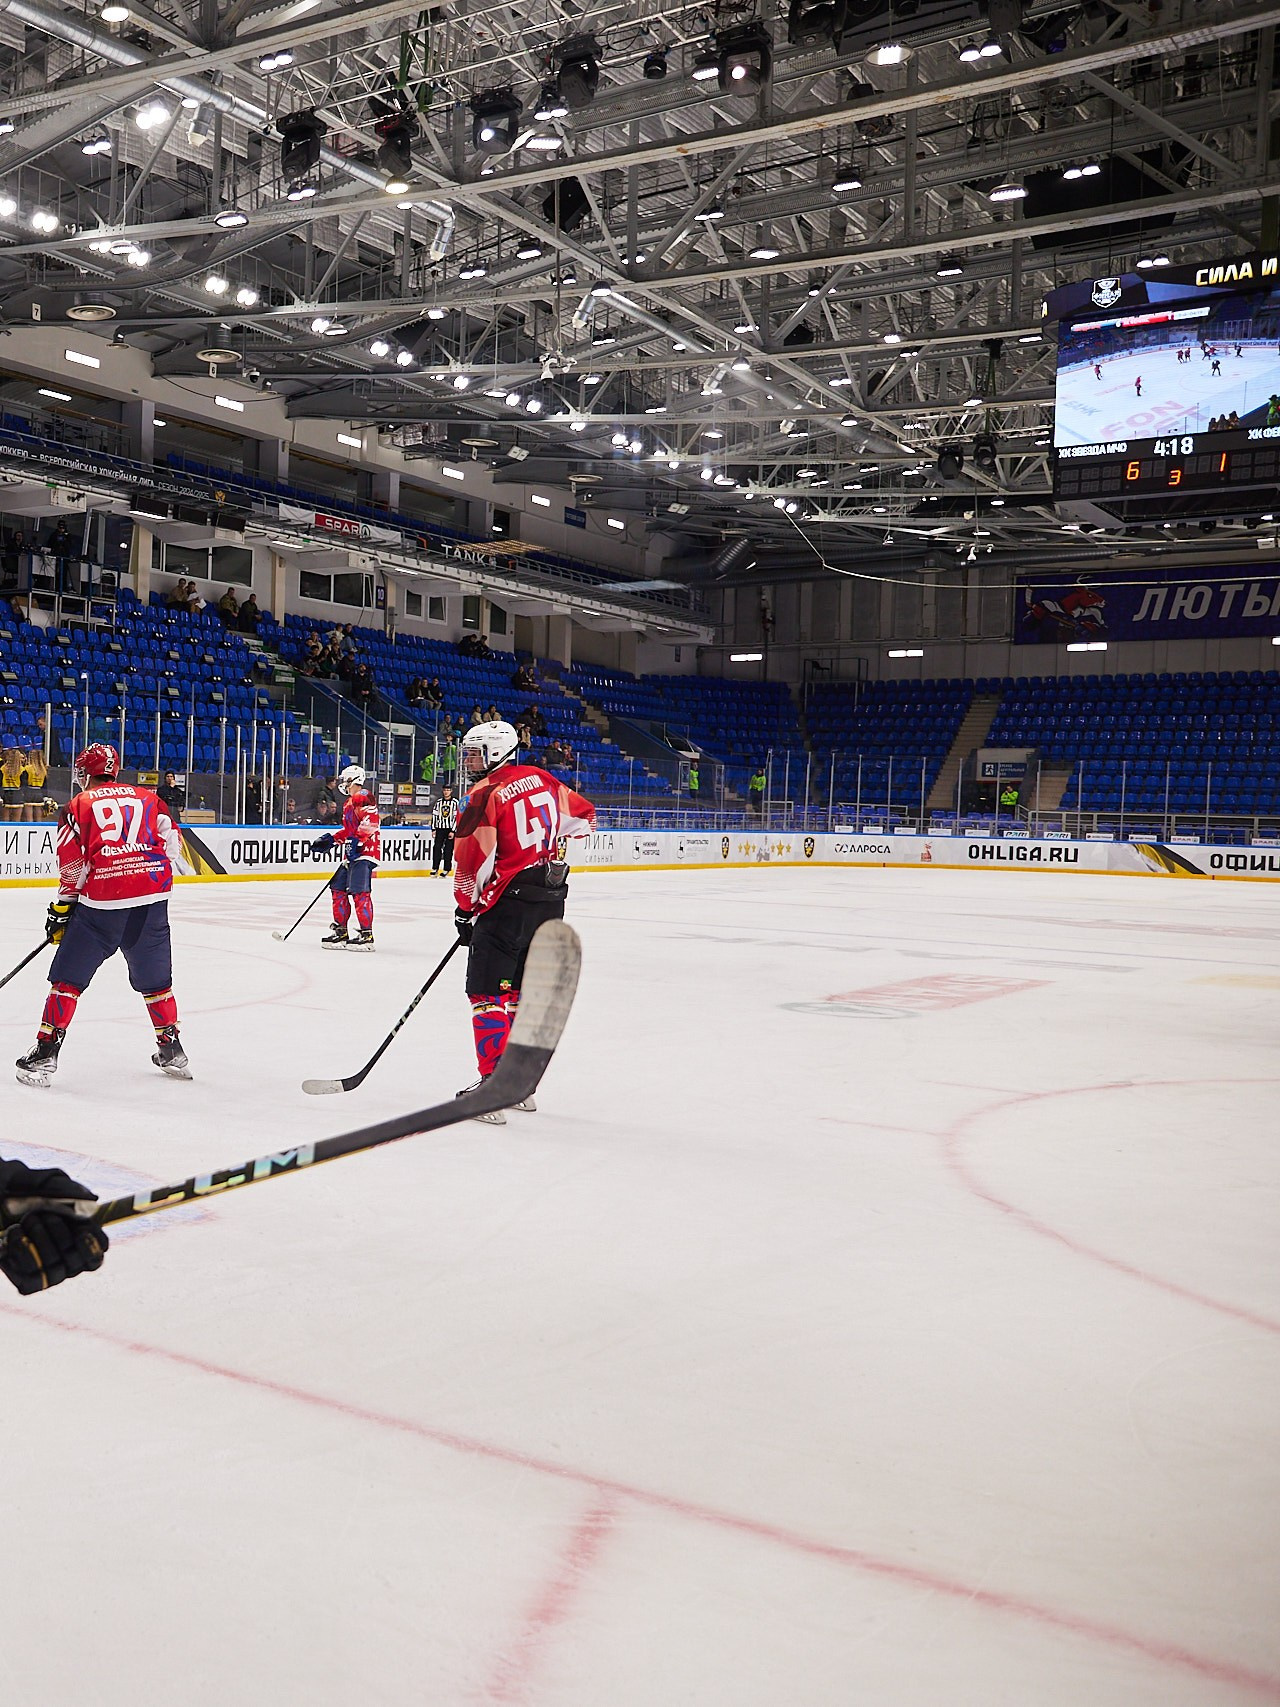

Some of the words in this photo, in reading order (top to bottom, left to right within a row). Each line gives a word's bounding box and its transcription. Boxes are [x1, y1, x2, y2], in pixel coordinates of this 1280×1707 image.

[1195, 261, 1253, 287] СИЛА
[1153, 436, 1194, 457] 4:18
[1126, 461, 1140, 480] 6
[1219, 452, 1227, 472] 1
[1168, 469, 1181, 486] 3
[325, 519, 359, 535] SPAR
[441, 543, 487, 567] TANK
[88, 786, 137, 800] ЛЕОНОВ
[91, 797, 144, 843] 97
[513, 791, 558, 852] 47
[231, 838, 344, 866] ОФИЦЕРСКА
[382, 833, 432, 863] ККЕЙН
[584, 834, 614, 850] ЛИГА
[968, 843, 1079, 864] OHLIGA.RU
[132, 1142, 315, 1212] CCM
